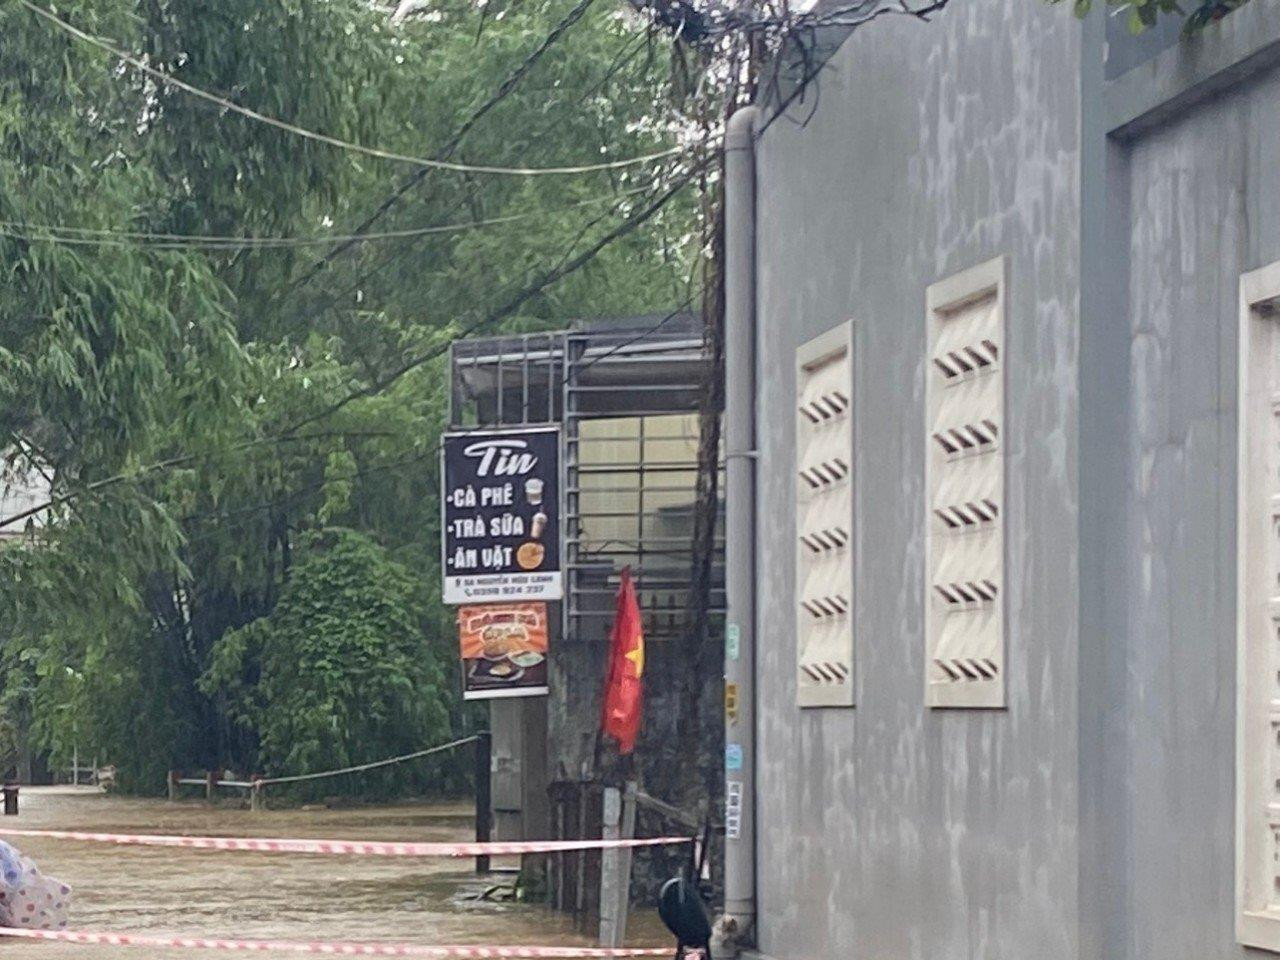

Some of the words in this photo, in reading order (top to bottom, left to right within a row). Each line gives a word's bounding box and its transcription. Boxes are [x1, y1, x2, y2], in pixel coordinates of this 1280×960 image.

[464, 439, 538, 477] Tin
[453, 484, 476, 507] CÀ
[481, 482, 513, 506] PHÊ
[454, 514, 486, 538] TRÀ
[490, 512, 524, 537] SỮA
[454, 546, 477, 569] ĂN
[481, 545, 513, 571] VẶT
